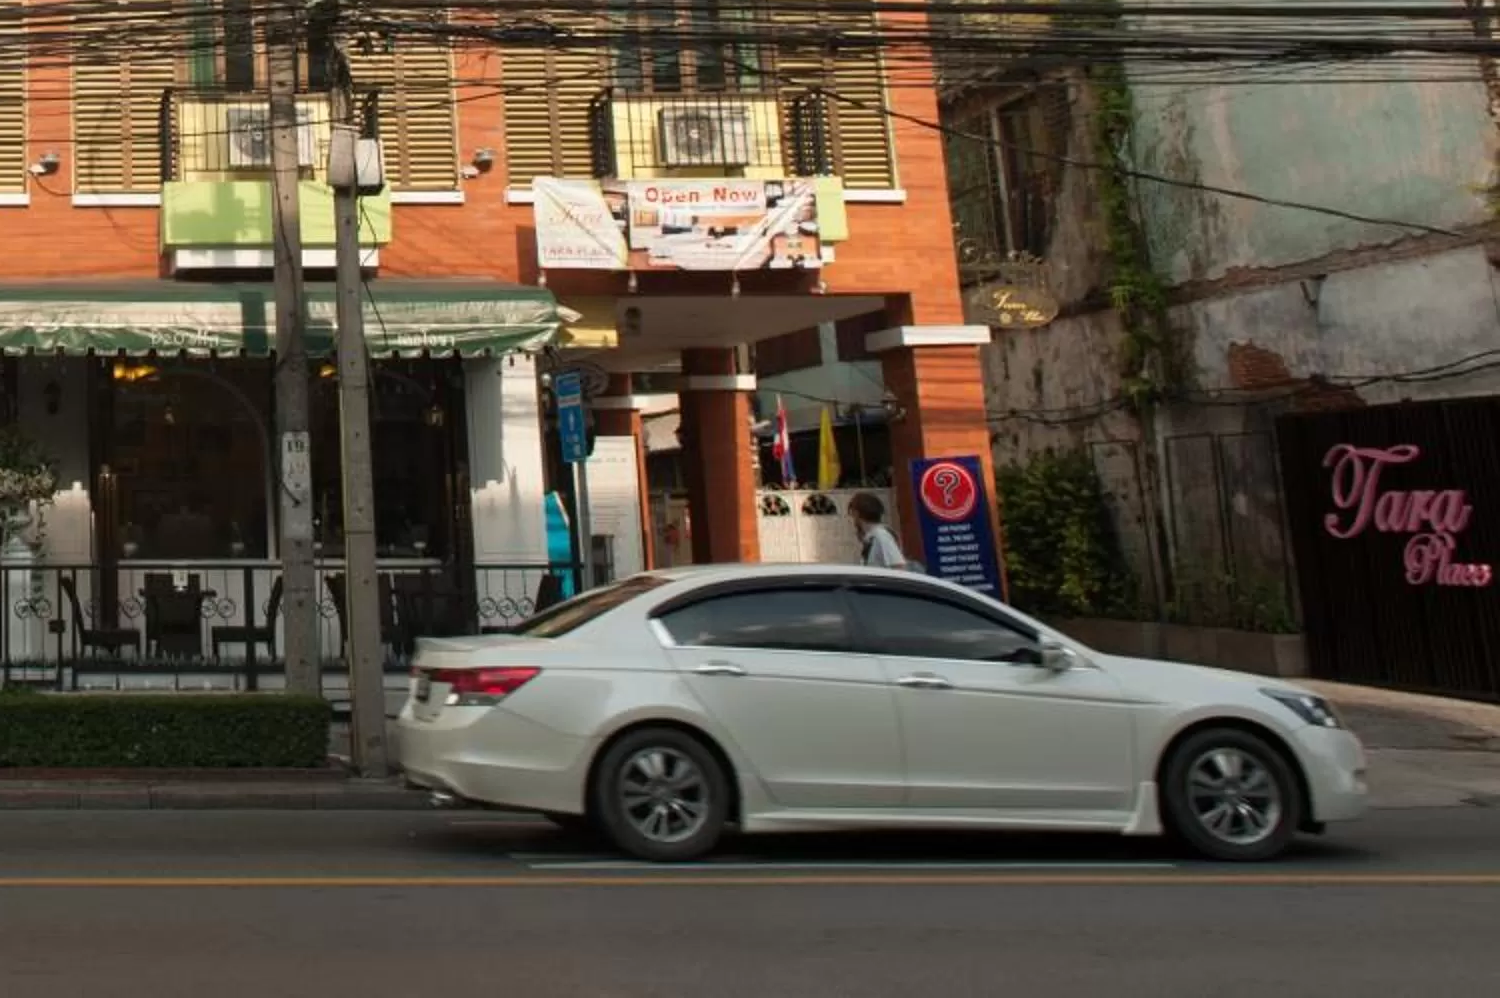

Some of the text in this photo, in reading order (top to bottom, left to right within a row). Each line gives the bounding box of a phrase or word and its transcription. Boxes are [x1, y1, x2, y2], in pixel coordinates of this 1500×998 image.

[644, 187, 758, 205] Open Now
[1322, 443, 1474, 539] Tara
[1404, 531, 1492, 586] Place
